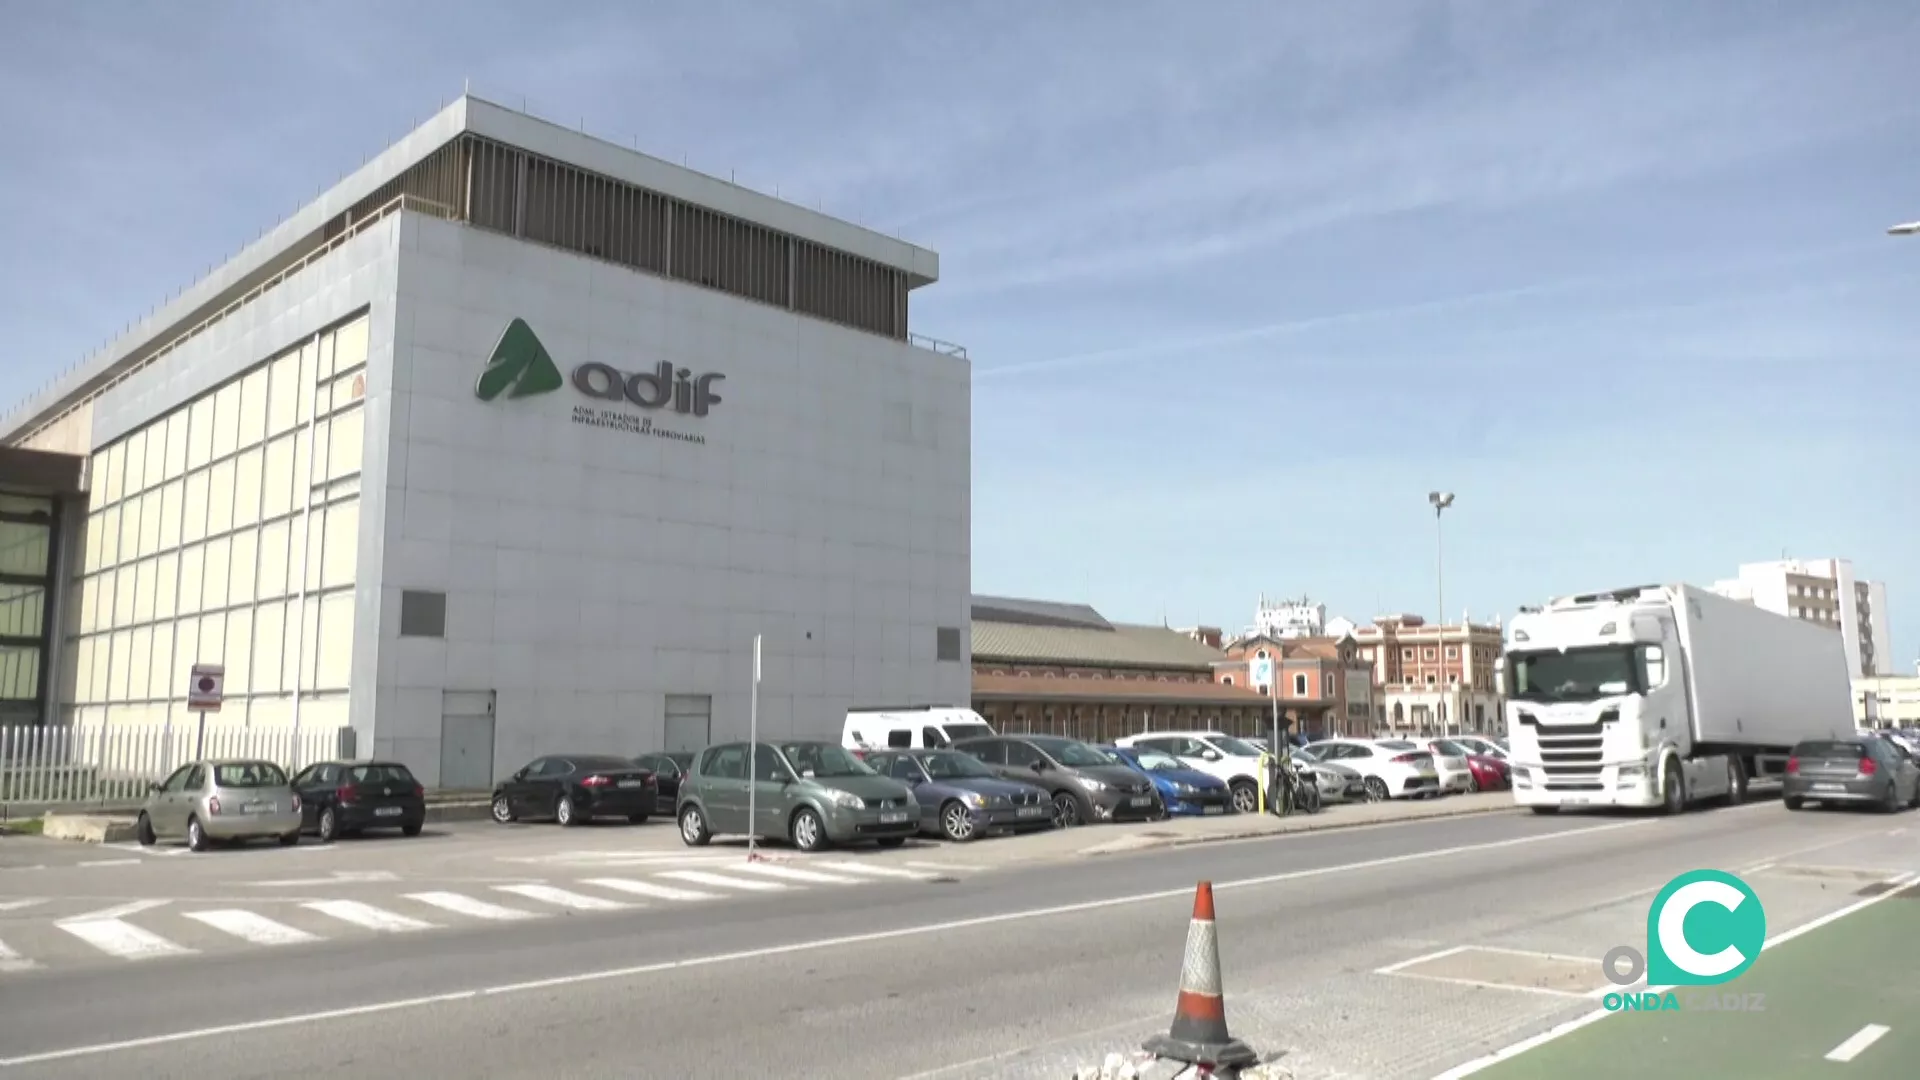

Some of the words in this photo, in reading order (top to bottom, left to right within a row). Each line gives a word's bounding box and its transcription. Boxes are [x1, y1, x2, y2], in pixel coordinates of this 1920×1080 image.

[571, 360, 726, 416] adif
[572, 414, 650, 435] INFRAESTRUCTURAS
[653, 427, 705, 444] FERROVIARIAS
[573, 405, 640, 425] ADMIISTRADOR
